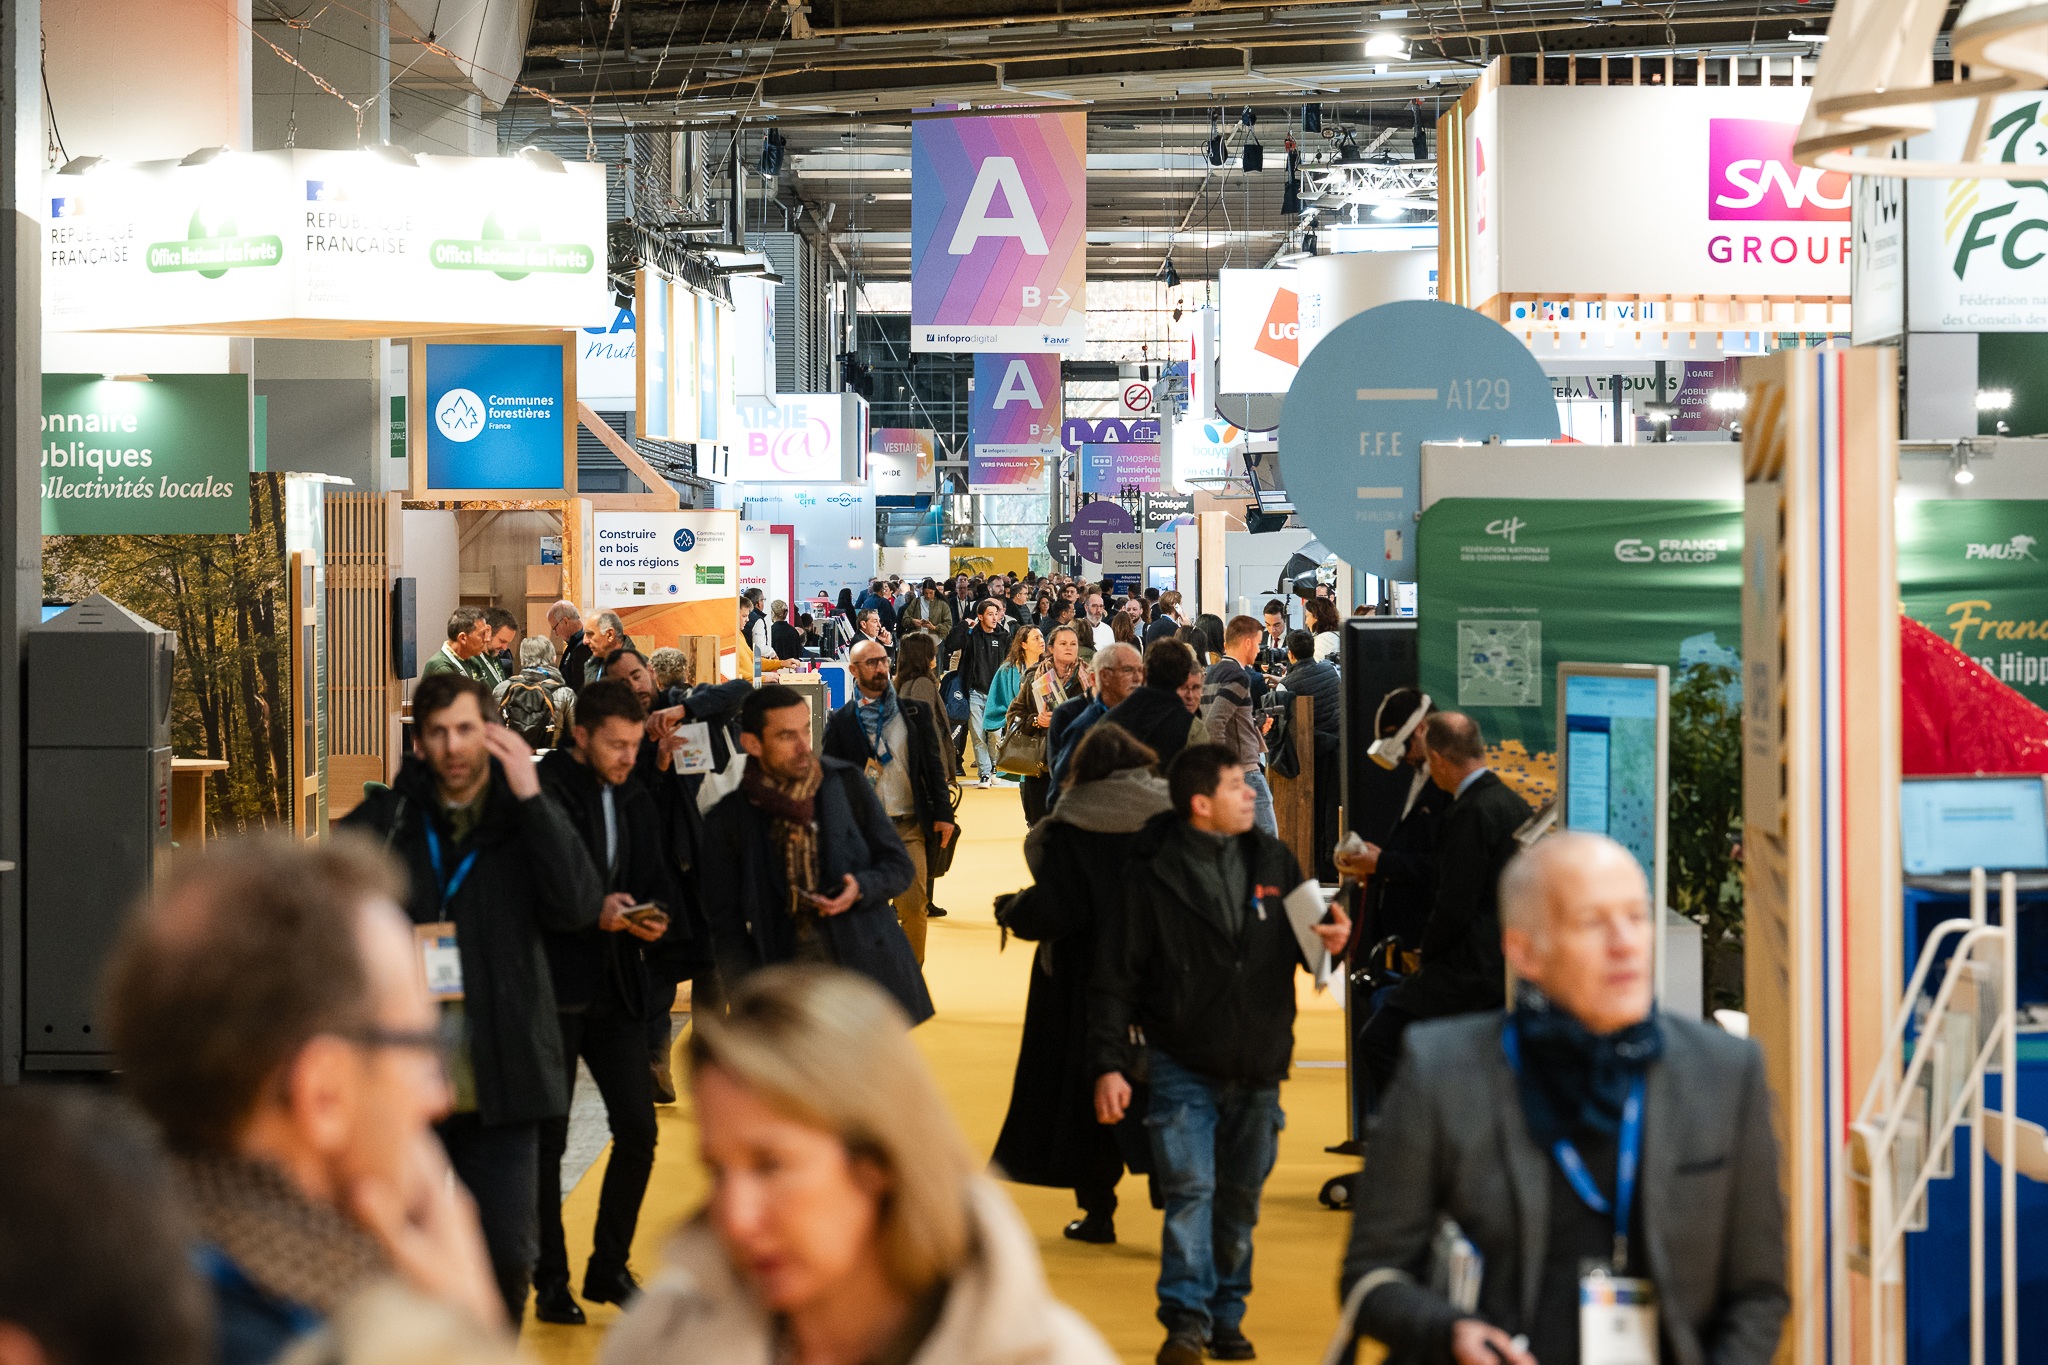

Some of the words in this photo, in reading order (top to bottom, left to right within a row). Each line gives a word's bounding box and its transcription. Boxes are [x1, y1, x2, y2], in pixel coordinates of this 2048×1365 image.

[948, 156, 1050, 256] A
[306, 234, 407, 254] FRANÇAISE
[51, 245, 129, 268] FRANÇAISE
[151, 248, 181, 267] Office
[181, 243, 225, 264] National
[435, 244, 473, 264] Office
[473, 246, 526, 266] National
[1022, 286, 1042, 308] B
[1959, 294, 2028, 307] Fédération
[1942, 312, 1964, 326] des
[1967, 312, 2022, 326] Conseils
[2025, 312, 2047, 326] des
[938, 333, 998, 344] infoprodigital
[1692, 370, 1714, 378] GARE
[992, 359, 1044, 410] A
[488, 394, 554, 406] Communes
[1446, 378, 1511, 411] A129
[488, 406, 551, 419] forestières
[488, 422, 512, 430] France
[1029, 424, 1040, 435] B
[1070, 427, 1084, 446] L
[1103, 426, 1120, 443] A
[884, 442, 923, 453] VESTIAIRE
[881, 469, 901, 477] WIDE
[1199, 467, 1214, 476] est
[158, 475, 234, 499] locales
[1149, 499, 1189, 511] Protéger
[599, 529, 657, 539] Construire
[599, 545, 613, 553] en
[616, 543, 639, 553] bois
[1659, 539, 1728, 551] FRANCE
[1659, 551, 1717, 562] GALOP
[599, 557, 614, 567] de
[616, 559, 636, 567] nos
[638, 557, 680, 569] régions
